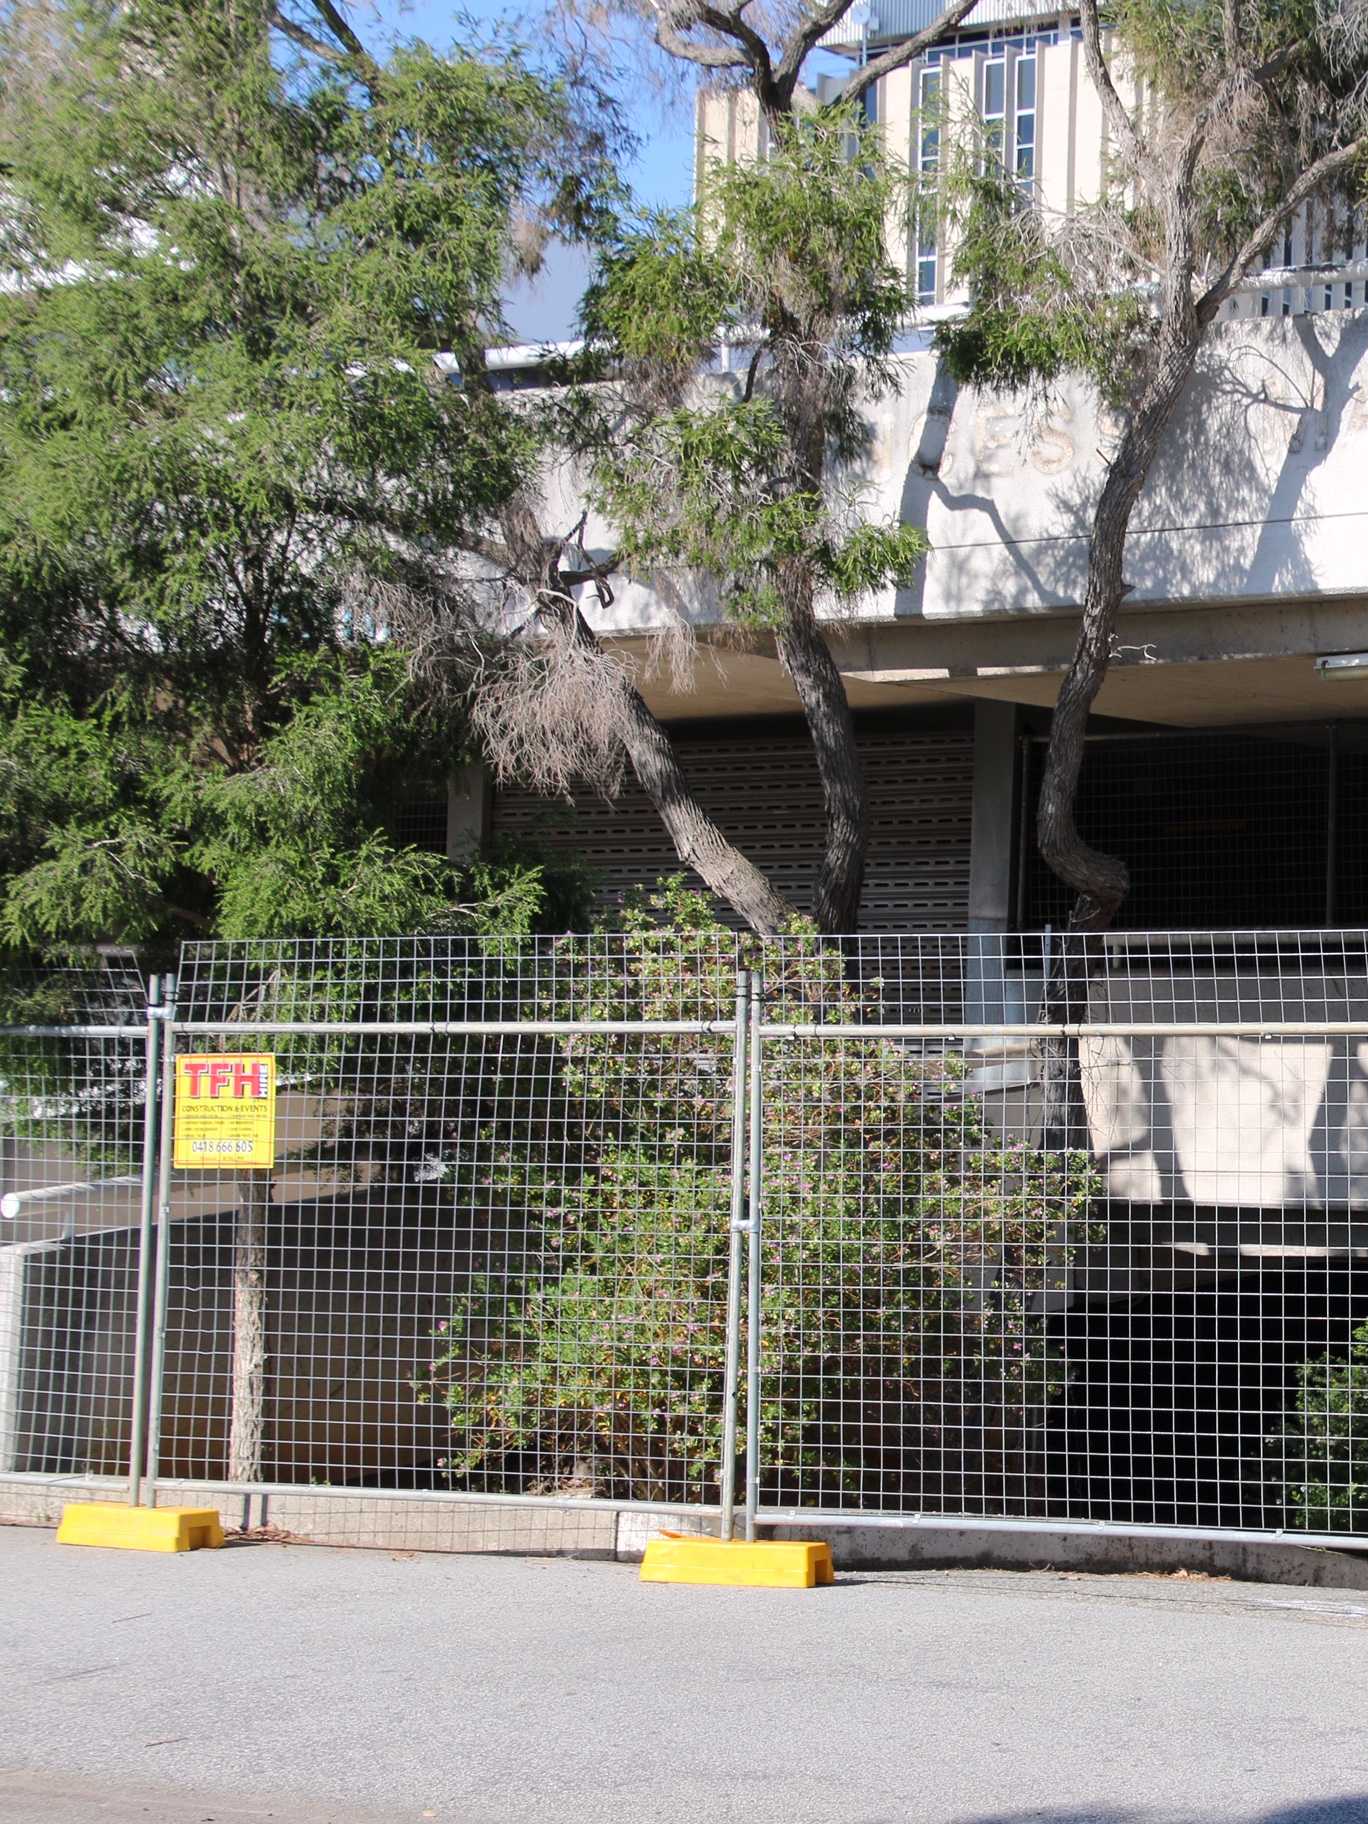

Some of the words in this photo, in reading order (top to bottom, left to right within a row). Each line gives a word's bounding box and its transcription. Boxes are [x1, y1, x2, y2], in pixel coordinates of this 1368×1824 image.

[184, 1063, 260, 1099] TFH
[240, 1104, 268, 1112] EVENTS
[192, 1141, 214, 1152] 0418
[215, 1142, 232, 1152] 666
[235, 1141, 253, 1152] 605
